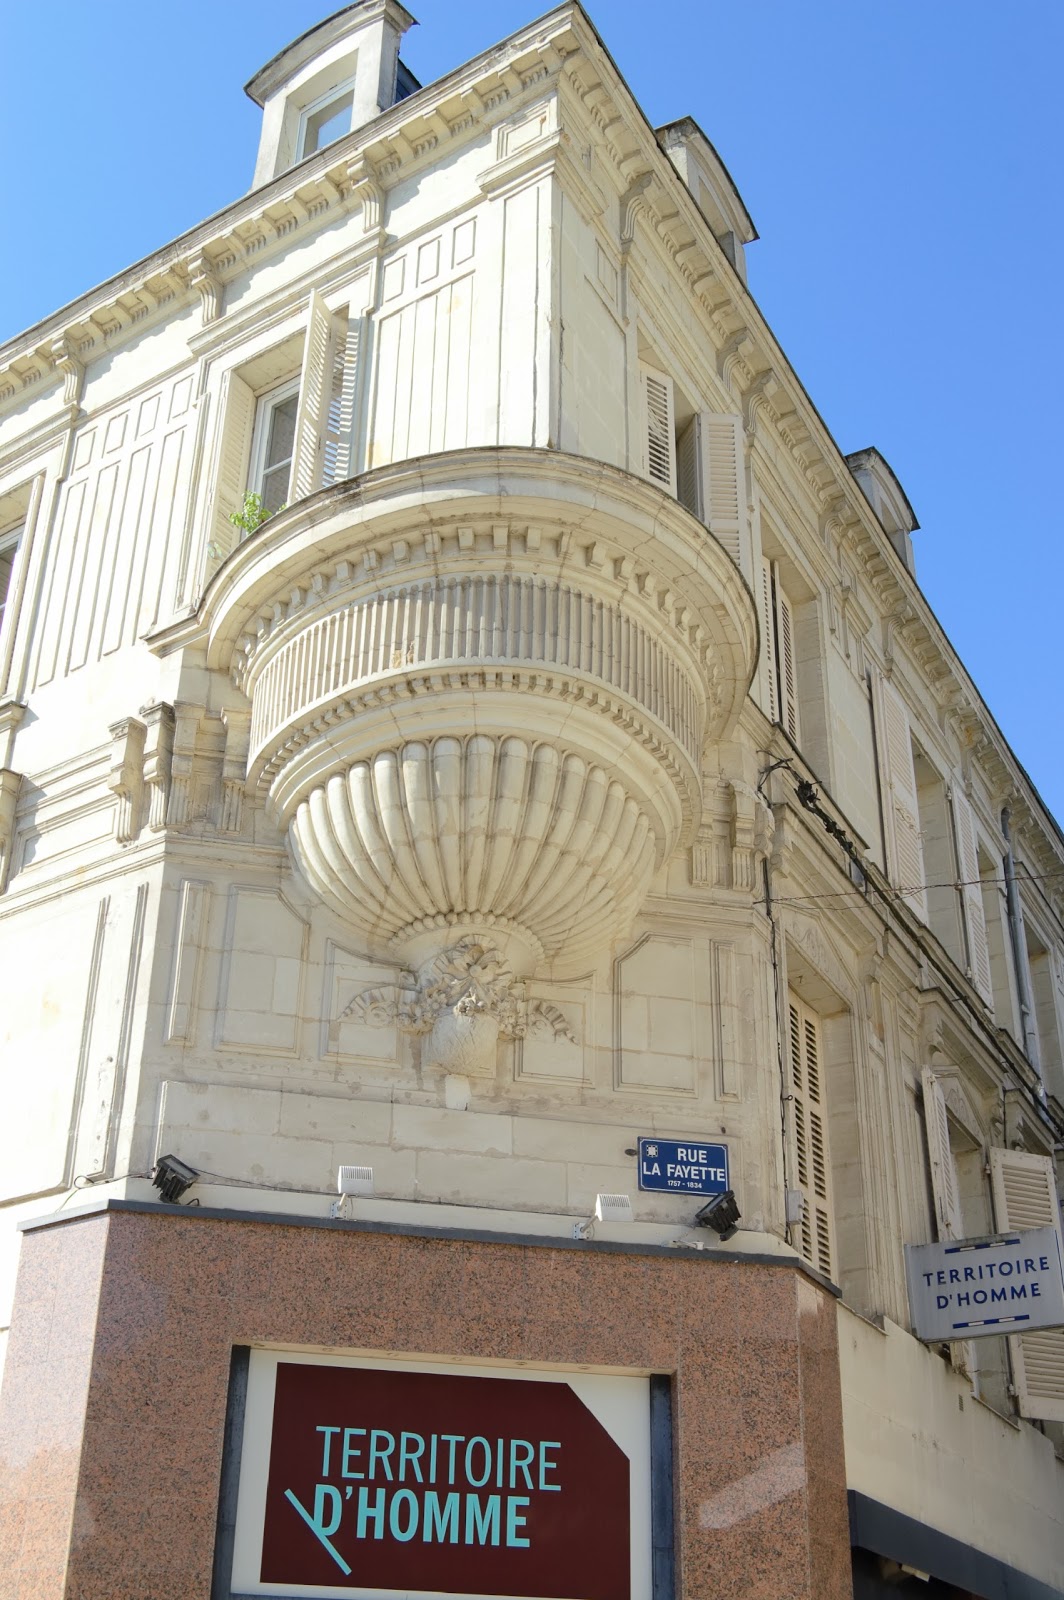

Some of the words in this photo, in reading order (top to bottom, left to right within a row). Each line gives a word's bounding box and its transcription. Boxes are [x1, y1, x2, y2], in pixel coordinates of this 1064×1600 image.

[677, 1148, 707, 1163] RUE
[643, 1162, 661, 1176] LA
[667, 1163, 725, 1181] FAYETTE
[923, 1256, 1050, 1287] TERRITOIRE
[936, 1282, 1042, 1310] D'HOMME
[315, 1425, 562, 1491] TERRITOIRE
[312, 1483, 531, 1549] D'HOMME
